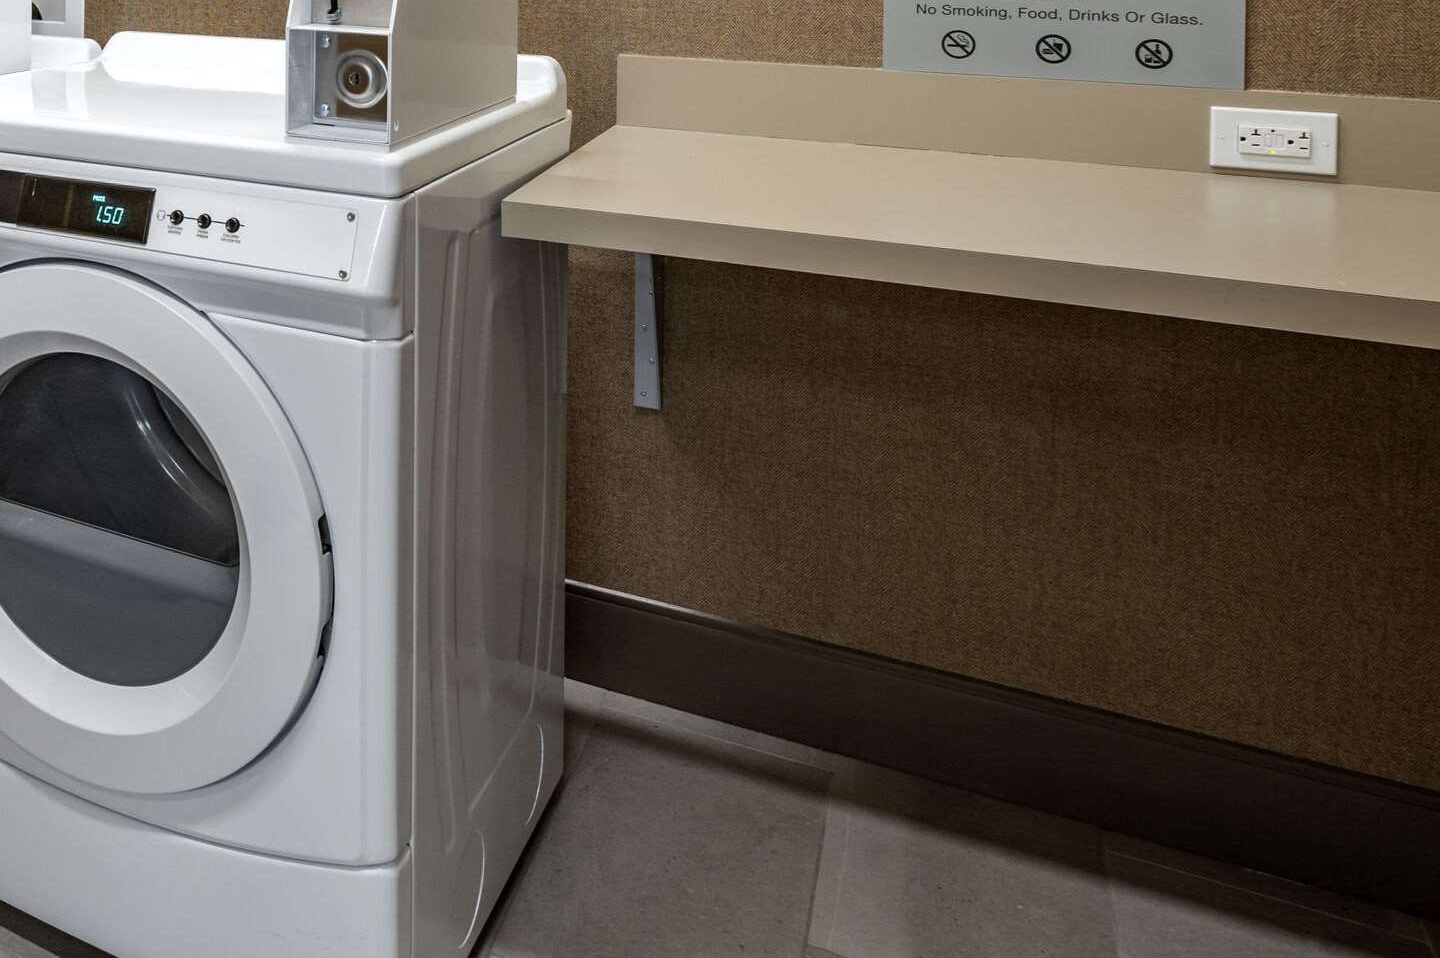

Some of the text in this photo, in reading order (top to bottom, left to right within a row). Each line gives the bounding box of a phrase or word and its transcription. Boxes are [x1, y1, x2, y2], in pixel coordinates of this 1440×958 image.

[916, 4, 1204, 26] No Smoking, Food, Drinks Or Glass.
[96, 205, 125, 225] 1.50
